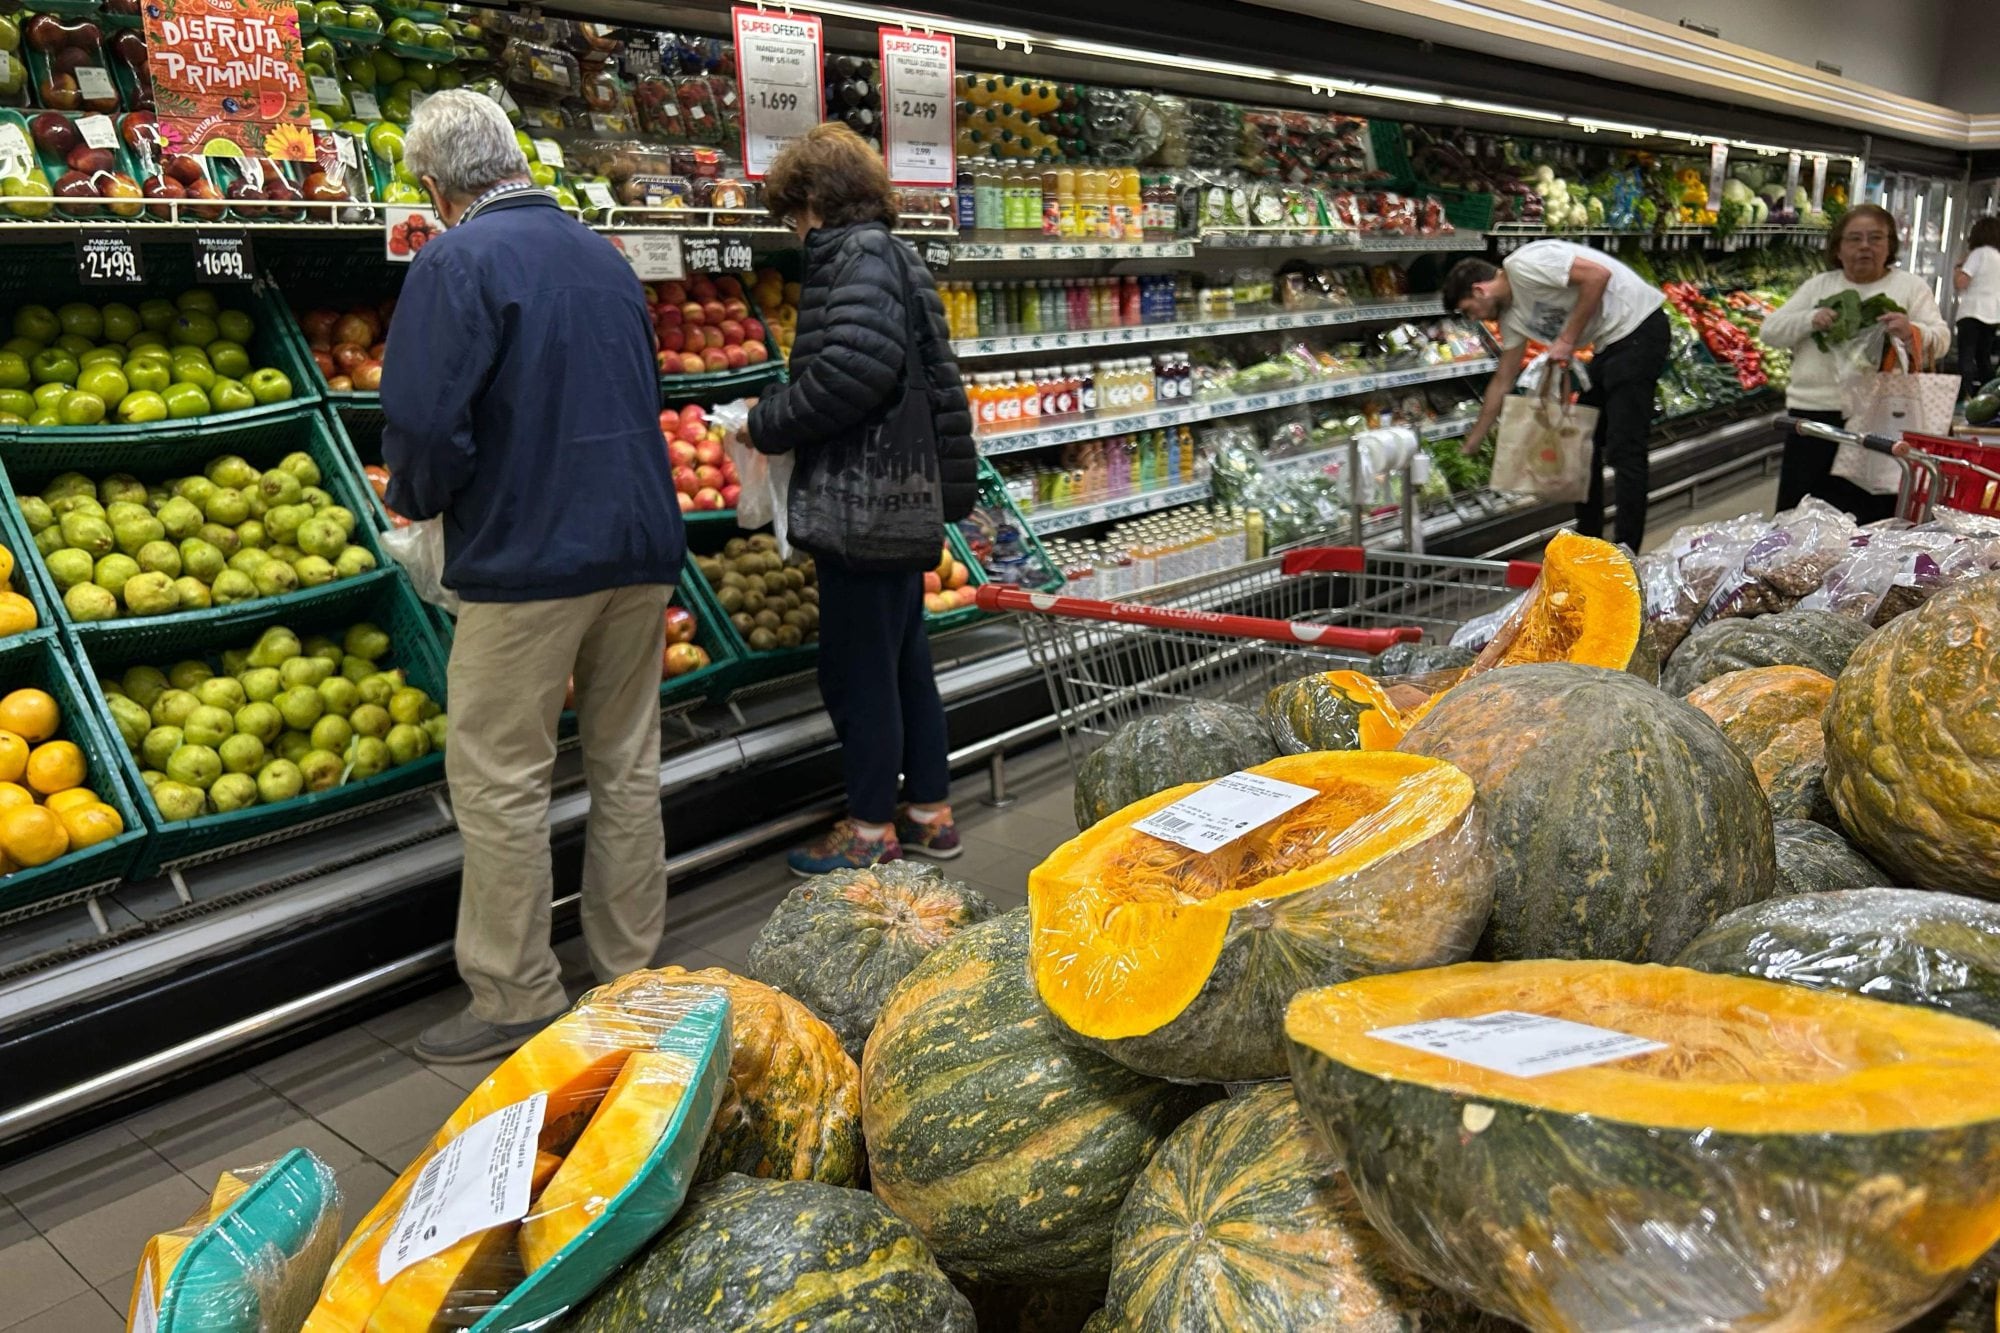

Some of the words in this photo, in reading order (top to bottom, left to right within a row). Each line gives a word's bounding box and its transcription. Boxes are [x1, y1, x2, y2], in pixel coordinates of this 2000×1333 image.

[162, 15, 283, 58] DISFRUTÁ
[194, 41, 219, 64] LA
[155, 54, 301, 94] PRIMAVERA
[760, 91, 798, 111] 1.699
[902, 101, 937, 119] 2.499
[188, 115, 223, 145] NATURAL
[87, 251, 136, 279] 2499
[203, 251, 243, 276] 1699
